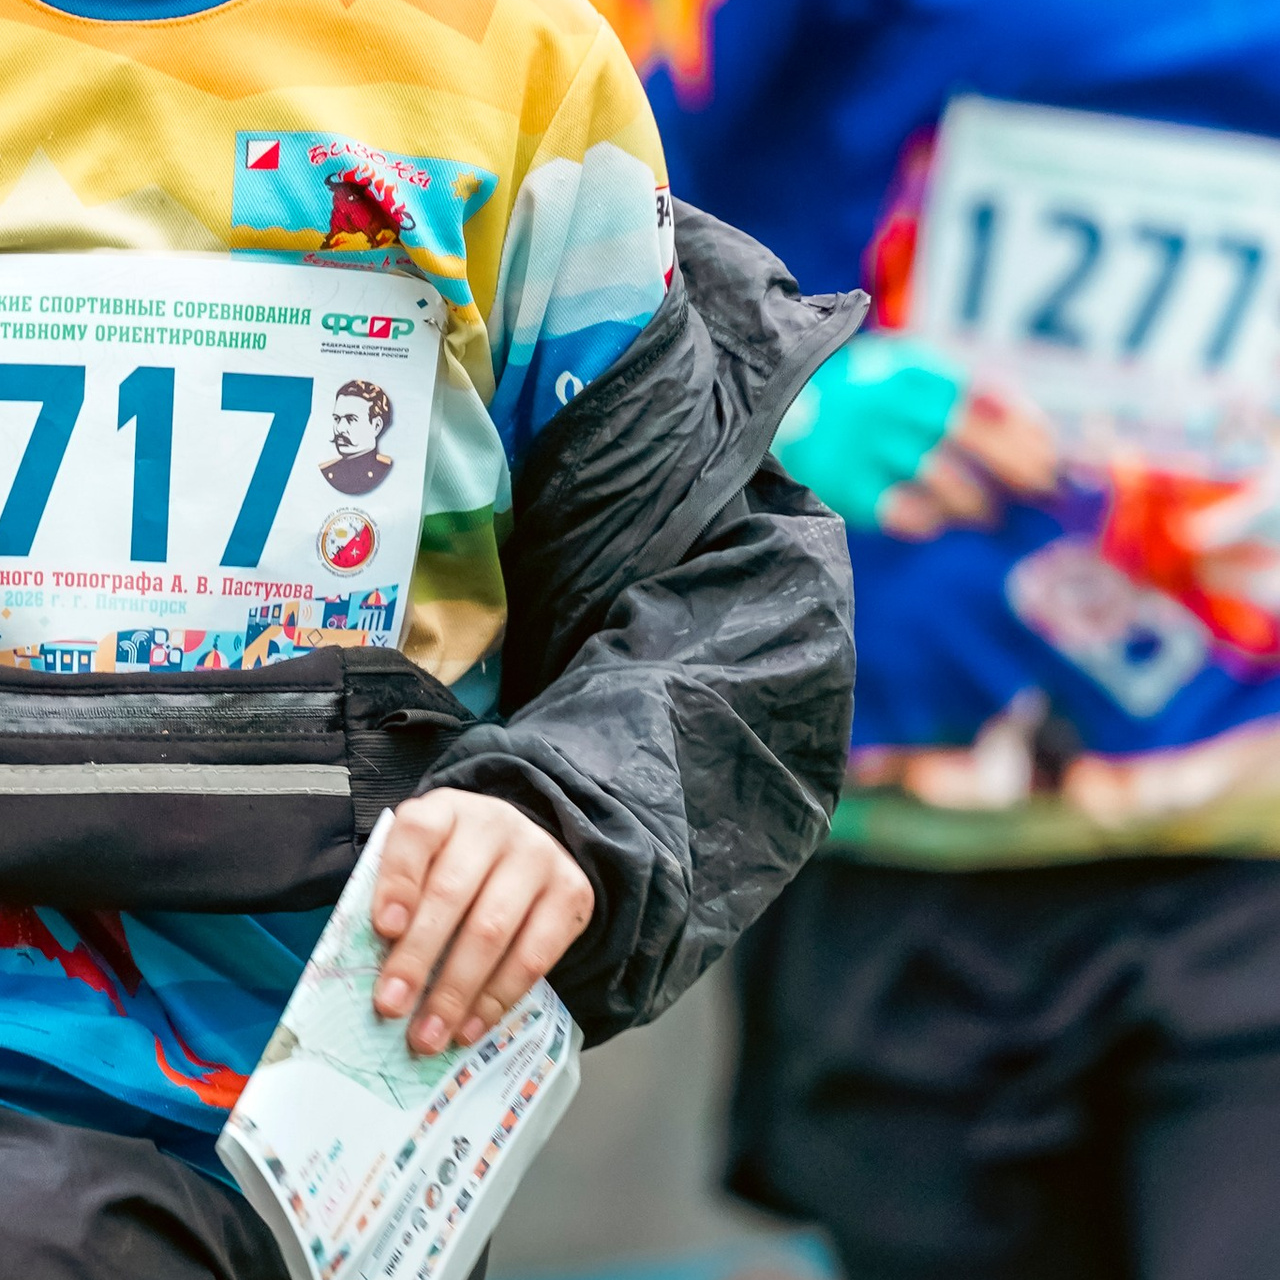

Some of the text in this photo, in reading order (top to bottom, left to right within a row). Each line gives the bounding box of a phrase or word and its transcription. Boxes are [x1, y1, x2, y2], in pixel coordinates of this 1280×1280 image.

[960, 199, 1265, 369] 1277
[39, 296, 166, 317] СПОРТИВНЫЕ
[173, 300, 312, 326] СОРЕВНОВАНИЯ
[95, 324, 268, 351] ОРИЕНТИРОВАНИЮ
[52, 571, 163, 596] топографа
[171, 575, 188, 594] А.
[196, 576, 213, 595] В.
[221, 577, 314, 602] Пастухова
[4, 590, 44, 608] 2026
[95, 594, 188, 618] Пятигорск
